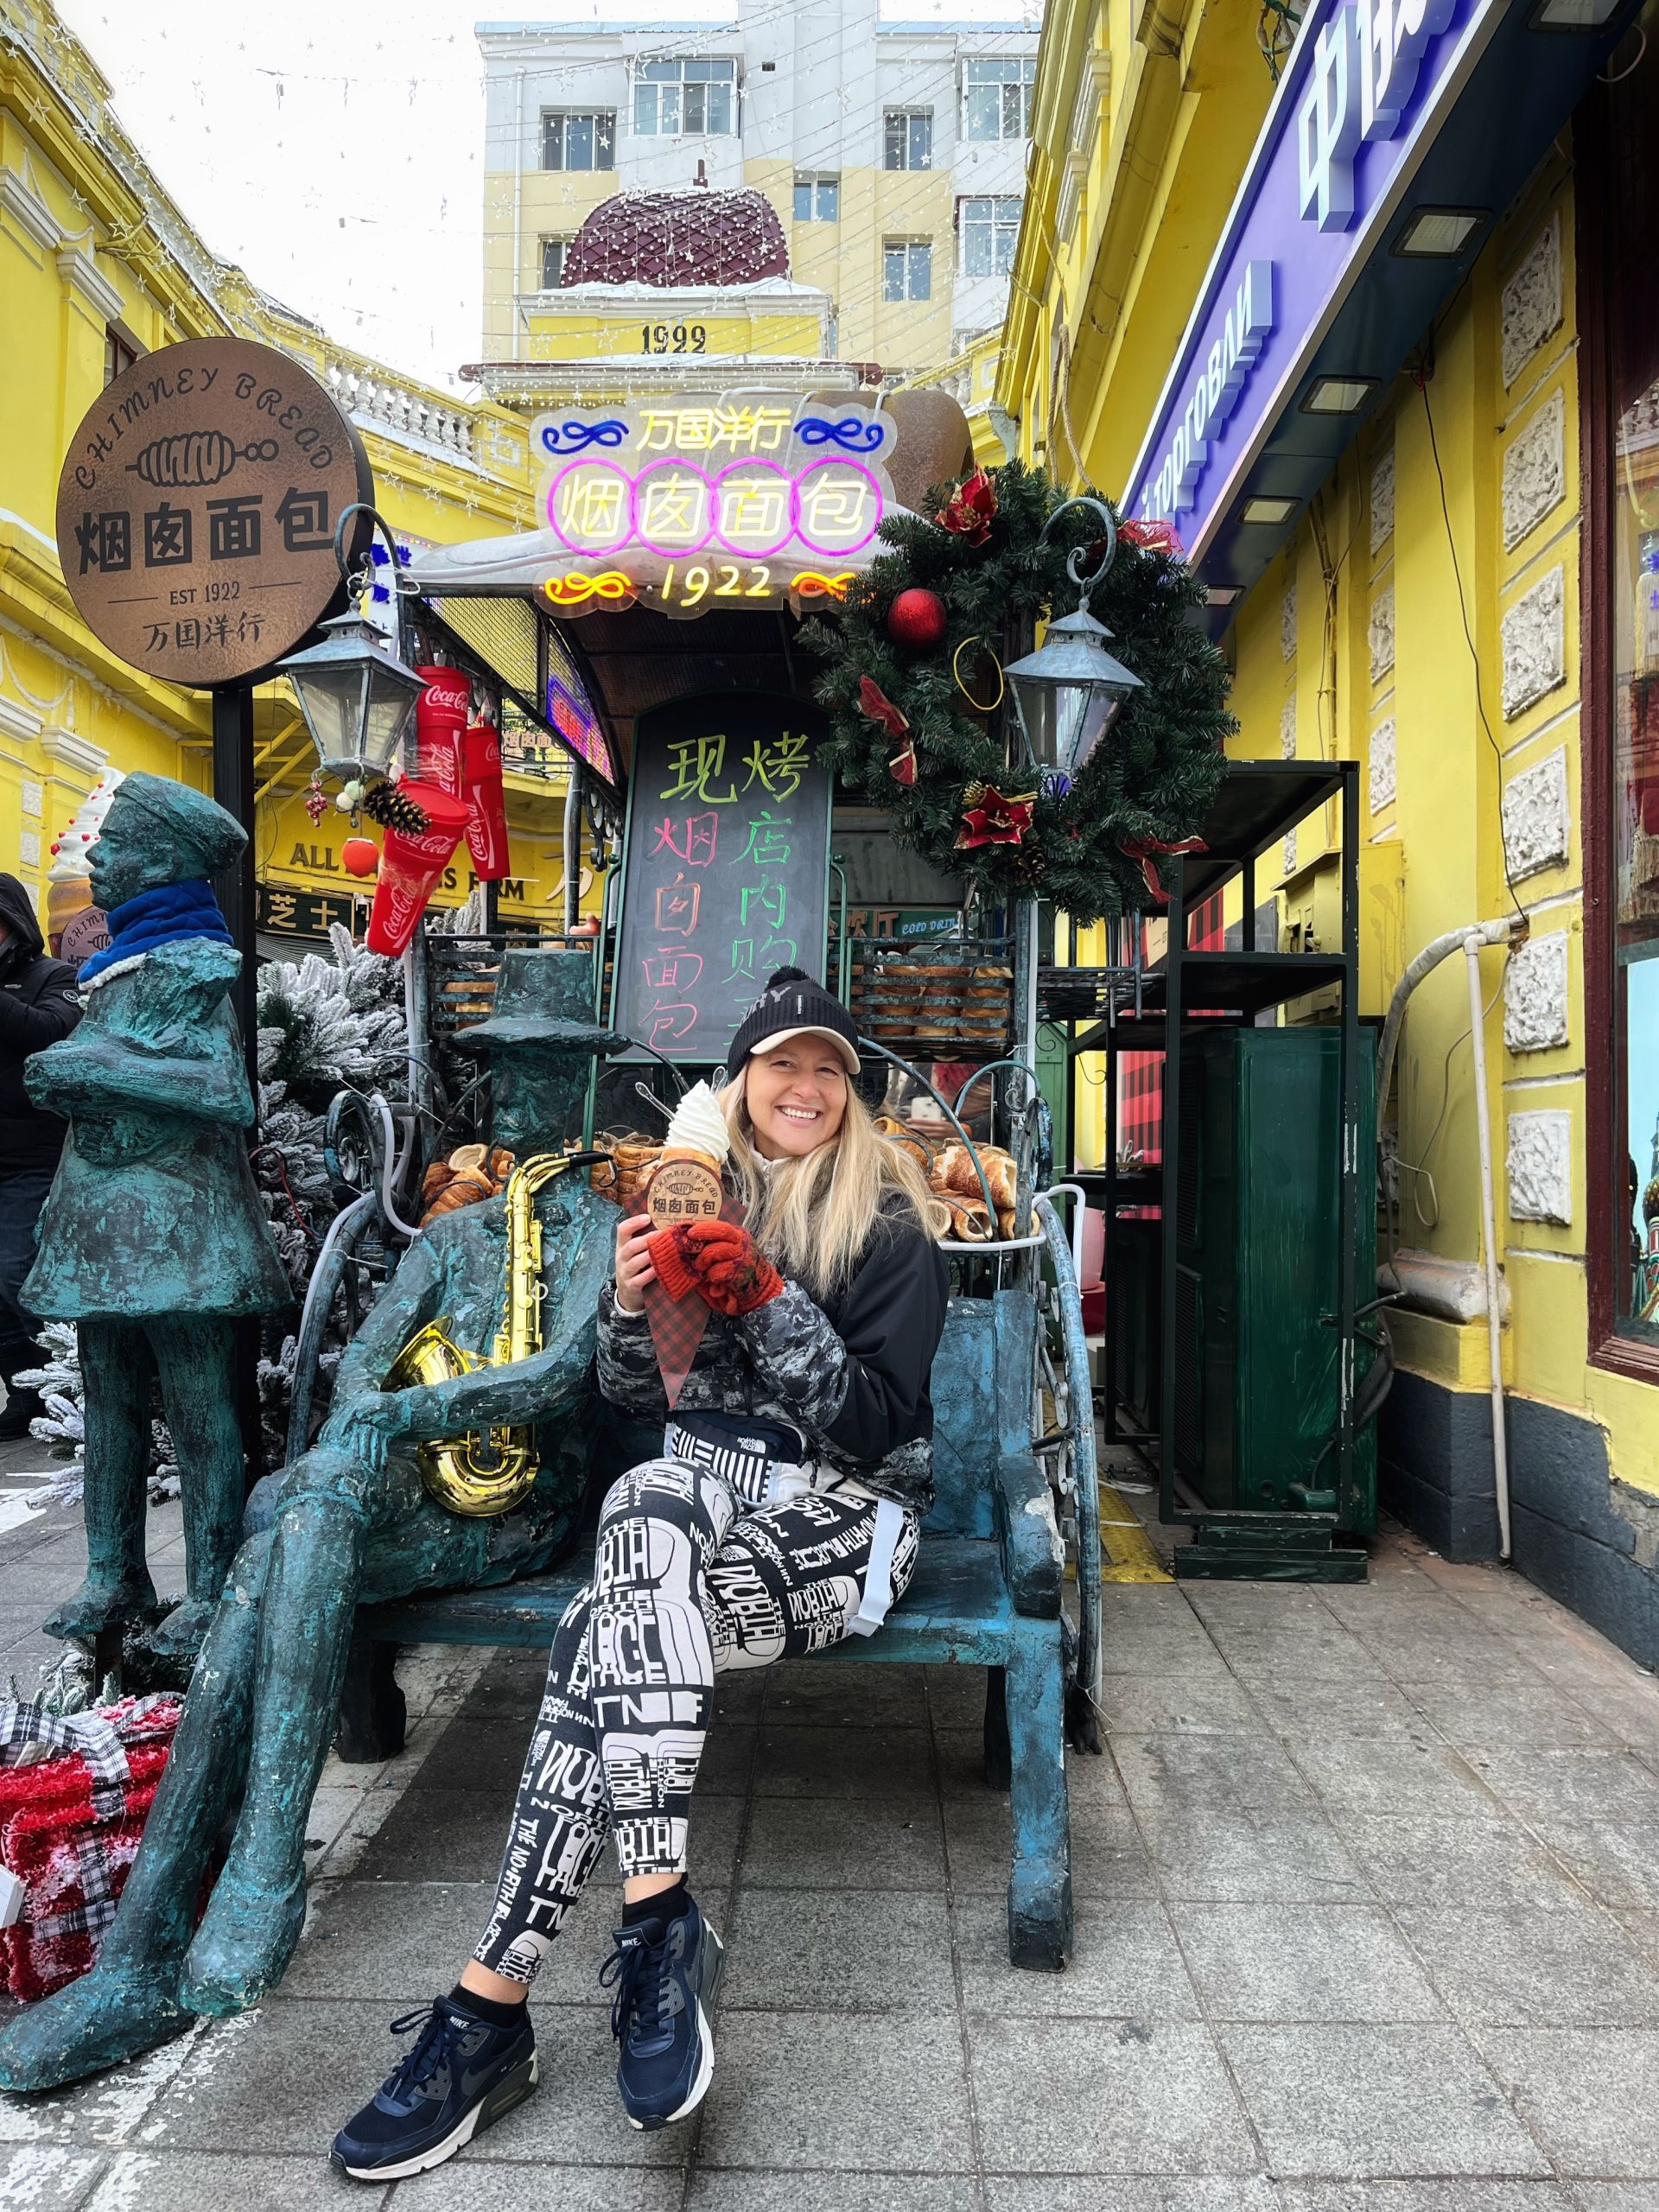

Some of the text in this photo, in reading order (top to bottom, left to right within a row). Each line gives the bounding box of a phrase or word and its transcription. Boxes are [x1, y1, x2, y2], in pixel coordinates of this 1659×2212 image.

[641, 325, 706, 354] 1922
[75, 367, 333, 490] CHIMNEY BREAD
[635, 405, 791, 452] 万国洋行
[562, 473, 868, 537] 烟囱面包
[74, 487, 335, 576] 烟囱面包
[169, 581, 240, 606] EST 1922
[661, 563, 772, 607] 1922
[143, 610, 266, 652] 万国洋行
[425, 684, 468, 713] Coca-Co
[659, 731, 810, 803] 现烤
[290, 842, 340, 871] ALL
[67, 912, 107, 947] CHIMN
[267, 893, 339, 931] 芝士
[654, 1169, 718, 1198] CHIMNEY BREAD
[653, 1198, 716, 1215] 烟囱面包
[621, 1937, 642, 1948] NIKE
[449, 2016, 469, 2030] NIKE
